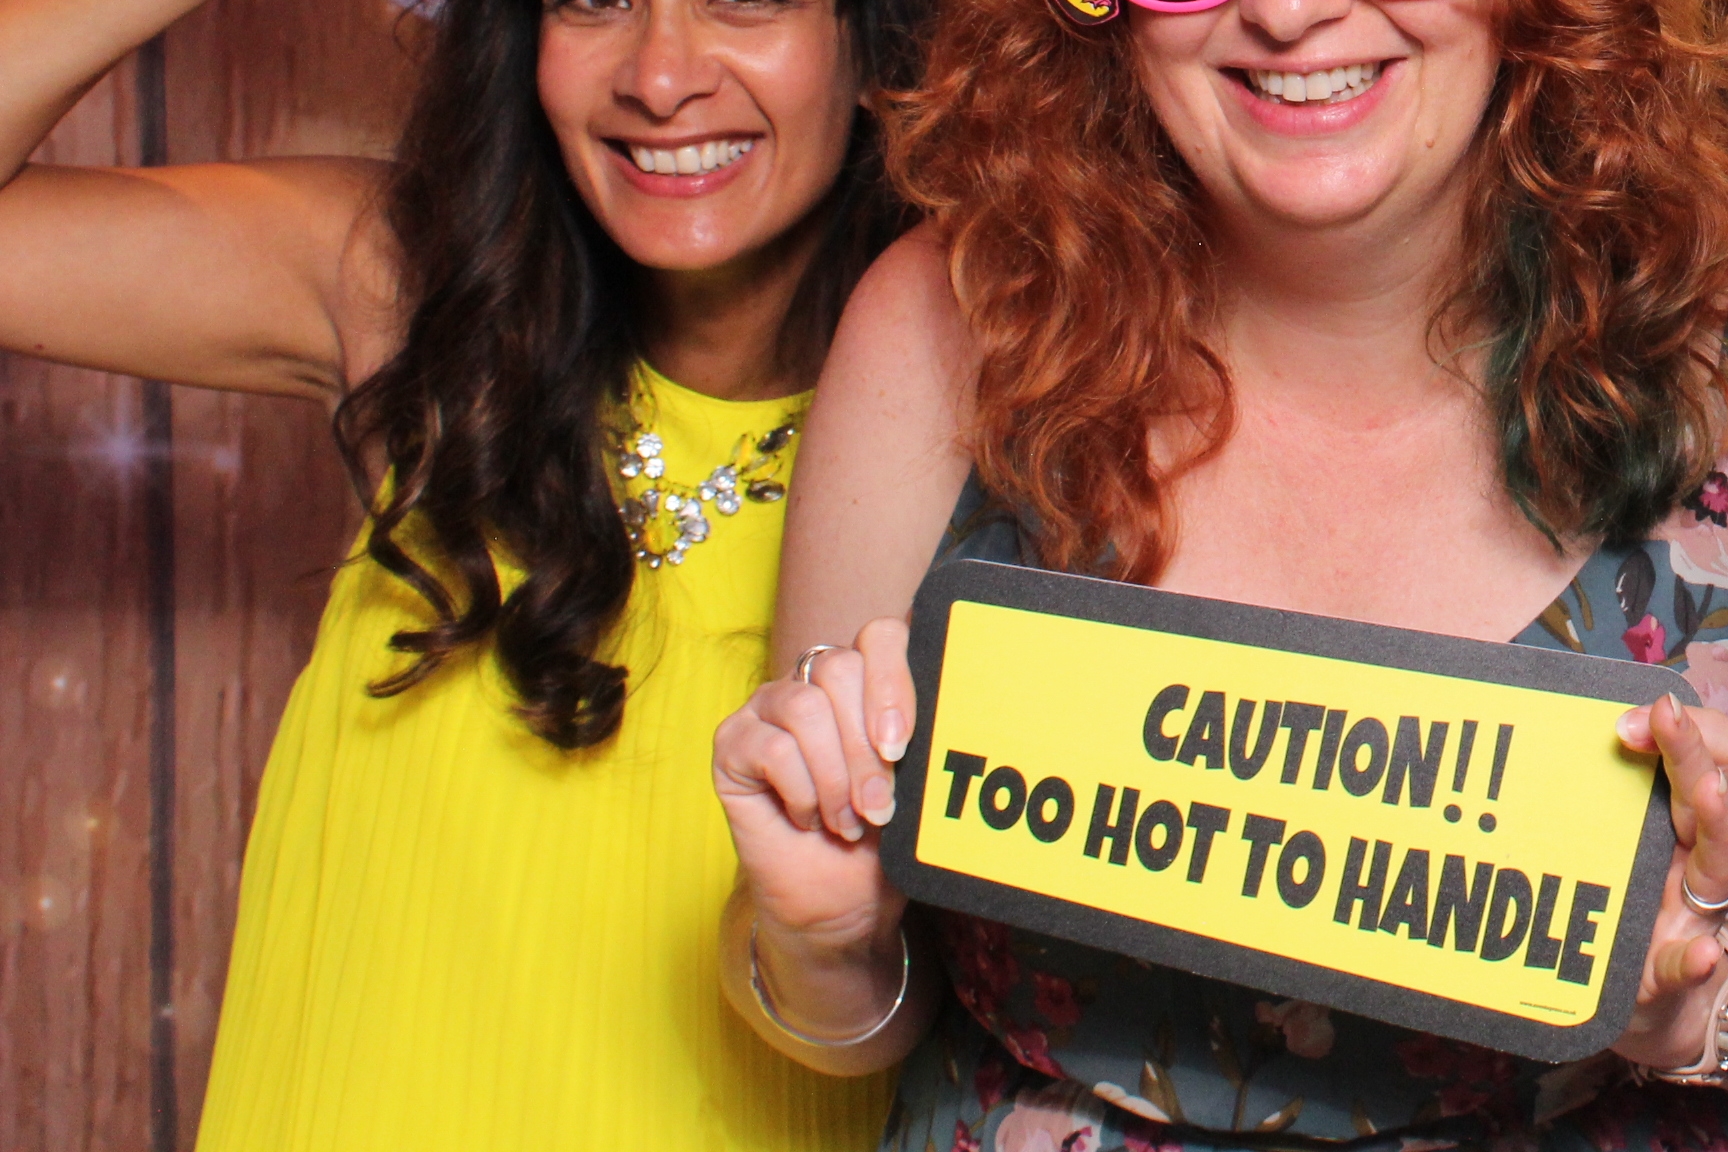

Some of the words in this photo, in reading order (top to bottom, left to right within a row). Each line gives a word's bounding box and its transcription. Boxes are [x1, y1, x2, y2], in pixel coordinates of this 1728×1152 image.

[1142, 683, 1514, 833] CAUTION!!
[943, 750, 1075, 842] TOO
[1083, 782, 1233, 883] HOT
[1242, 812, 1326, 910] TO
[1334, 835, 1612, 987] HANDLE
